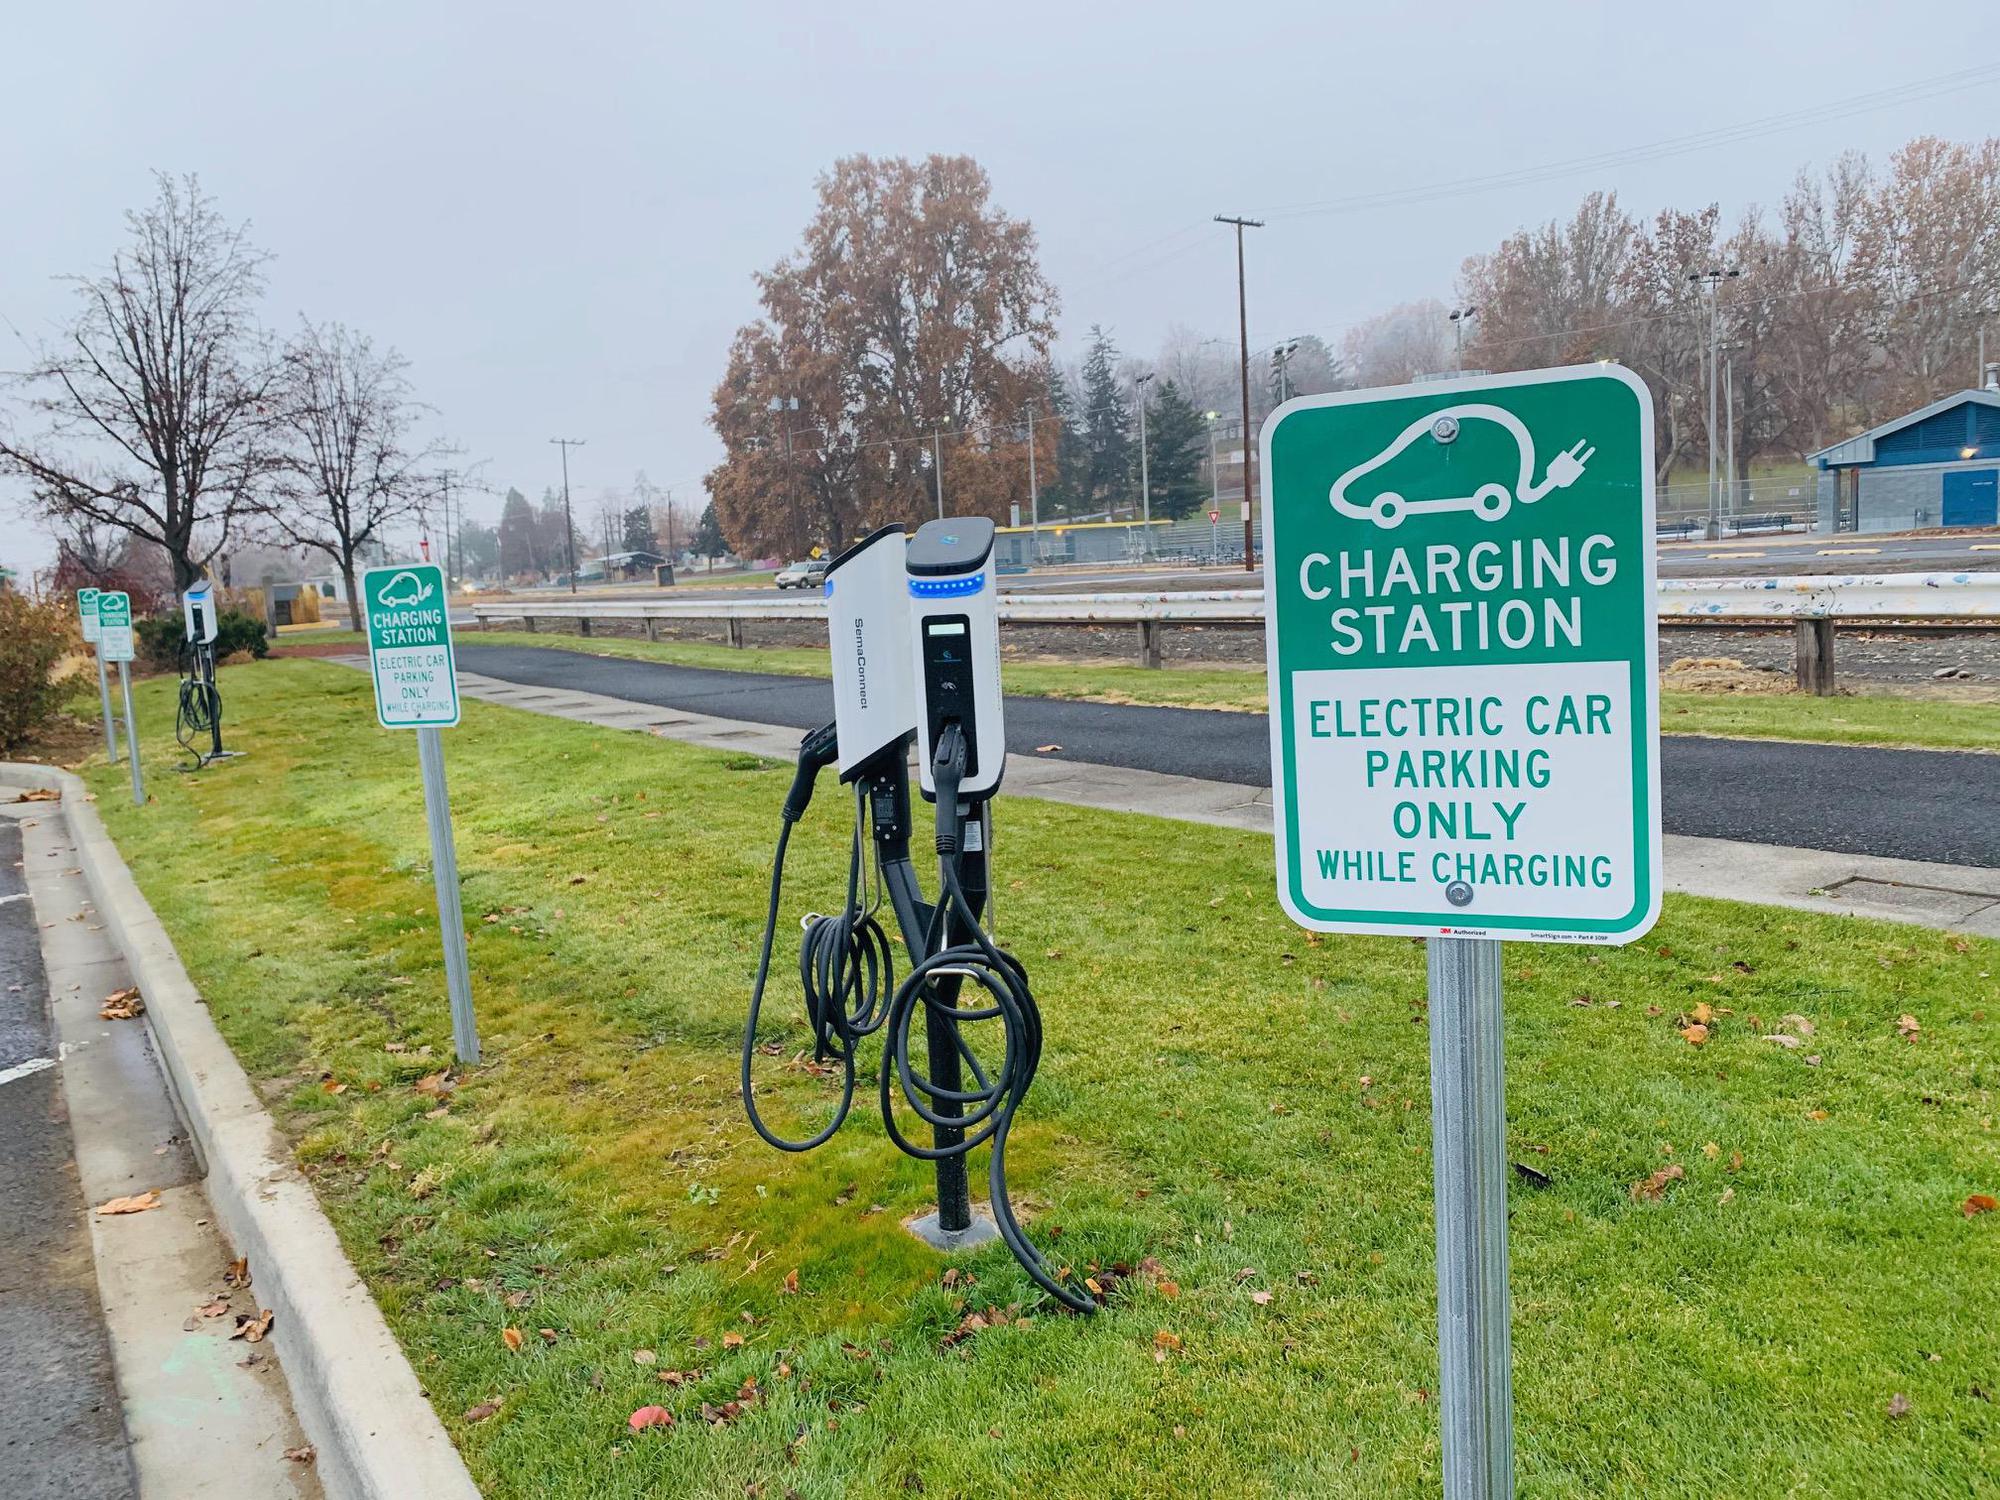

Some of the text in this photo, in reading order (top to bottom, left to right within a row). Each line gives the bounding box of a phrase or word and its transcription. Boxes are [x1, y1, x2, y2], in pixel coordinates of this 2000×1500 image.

[1299, 534, 1617, 600] CHARGING
[373, 609, 442, 629] CHARGING
[382, 628, 437, 645] STATION
[1330, 597, 1582, 655] STATION
[380, 654, 445, 670] ELECTRIC CAR
[394, 671, 434, 683] PARKING
[854, 618, 868, 710] SemaConnect
[386, 703, 409, 713] WHILE
[401, 686, 431, 699] ONLY
[1310, 694, 1612, 738] ELECTRIC CAR
[1366, 748, 1551, 789] PARKING
[1393, 801, 1527, 841] ONLY
[1316, 849, 1612, 889] WHILE CHARGING
